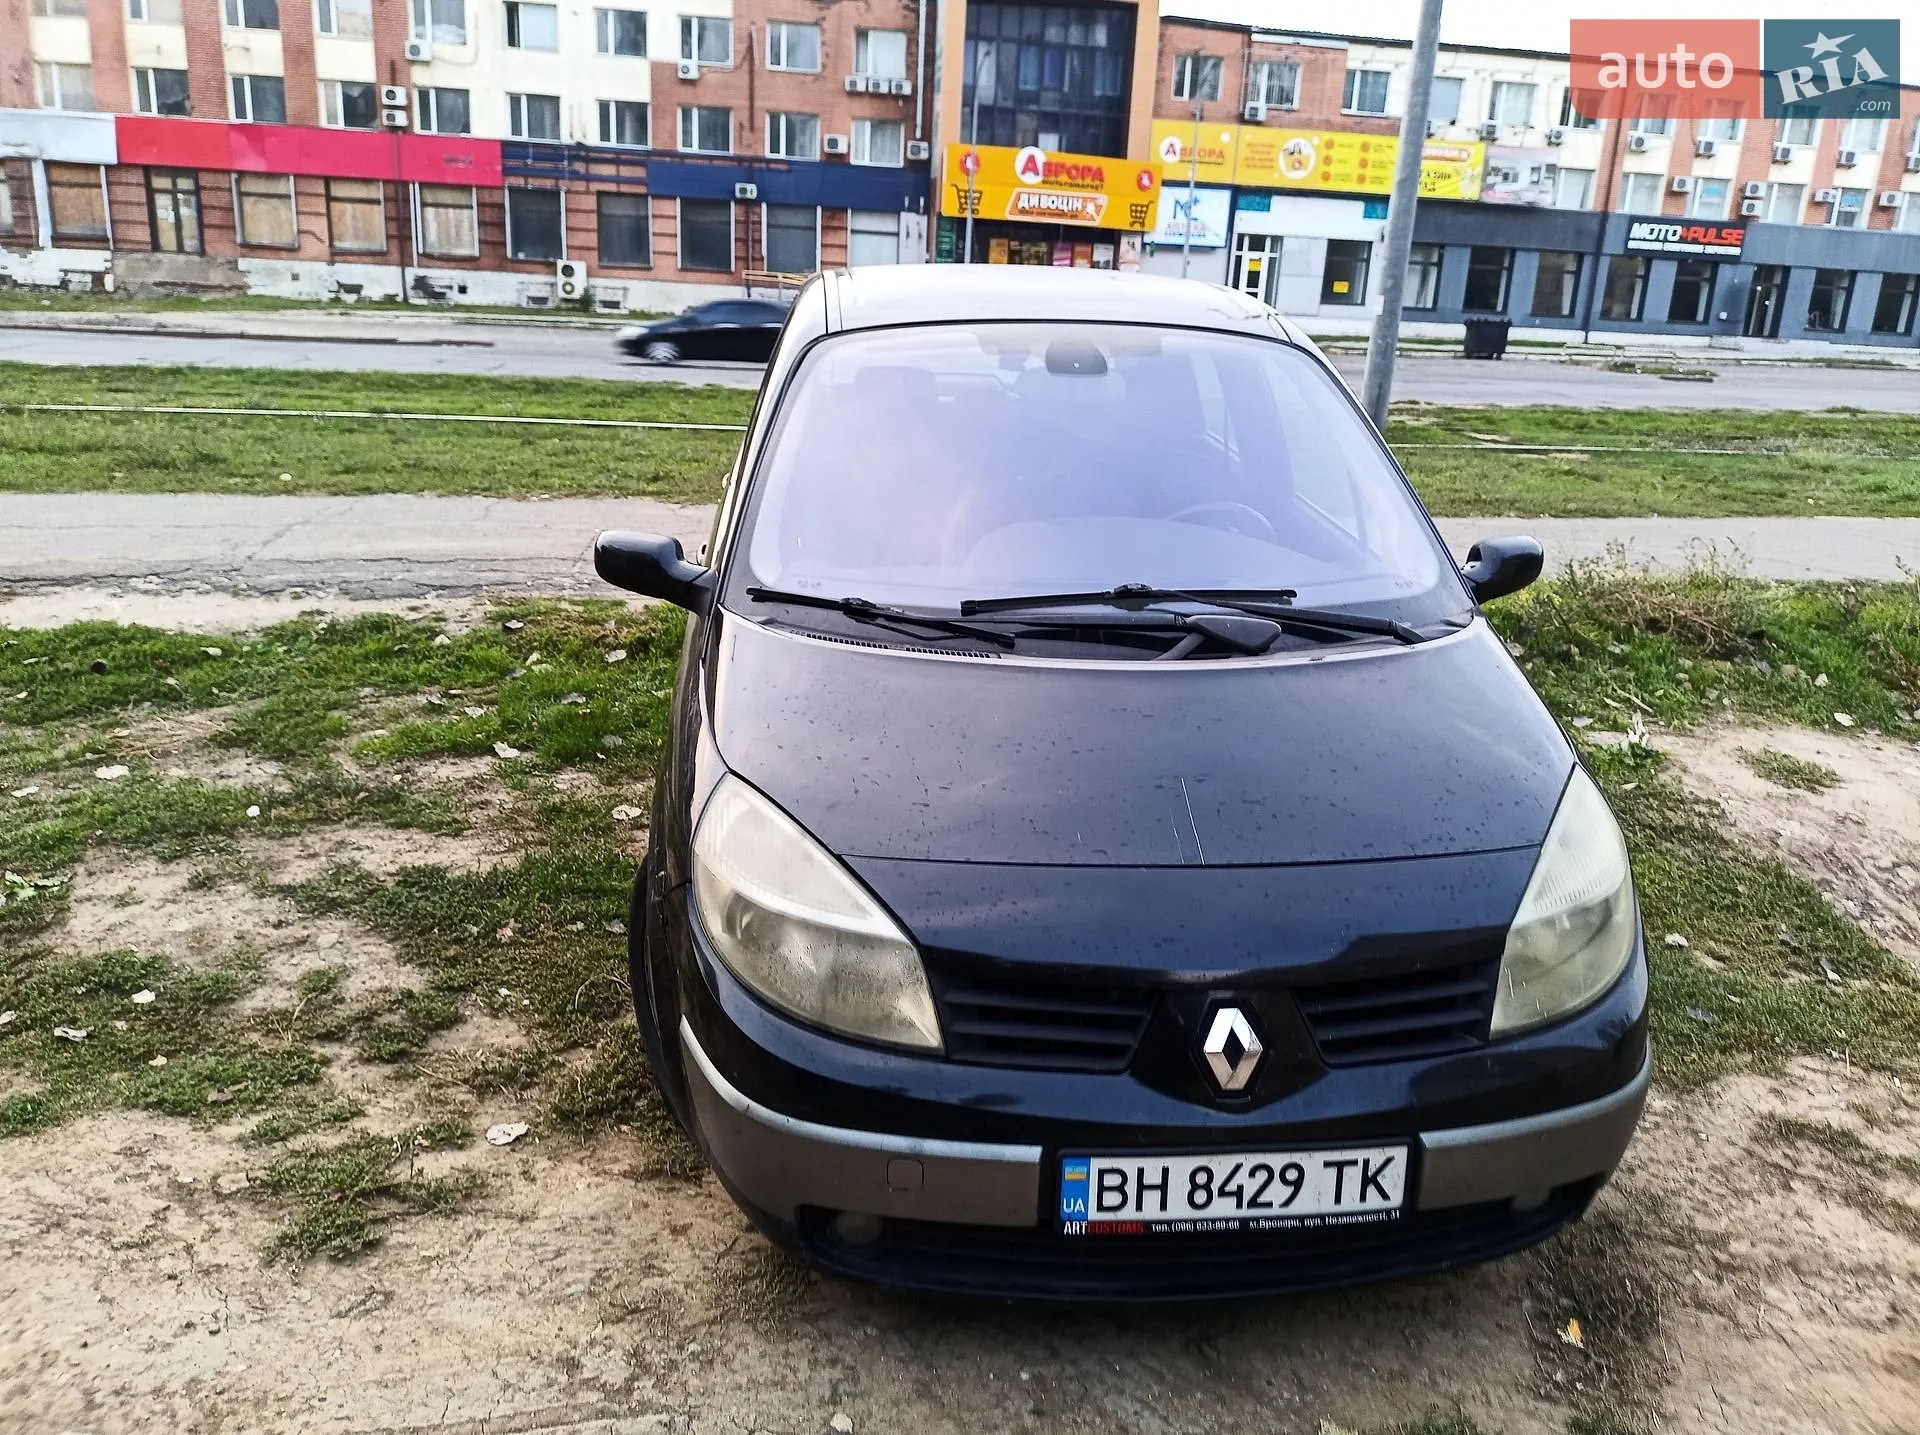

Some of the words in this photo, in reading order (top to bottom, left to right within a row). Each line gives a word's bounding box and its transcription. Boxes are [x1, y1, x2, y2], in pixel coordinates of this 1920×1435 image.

[1020, 154, 1105, 182] АВРОРА
[1629, 222, 1682, 242] MOTO
[1096, 1166, 1170, 1213] BH
[1187, 1161, 1306, 1211] 8429
[1323, 1155, 1396, 1206] TK
[1063, 1198, 1086, 1214] UA
